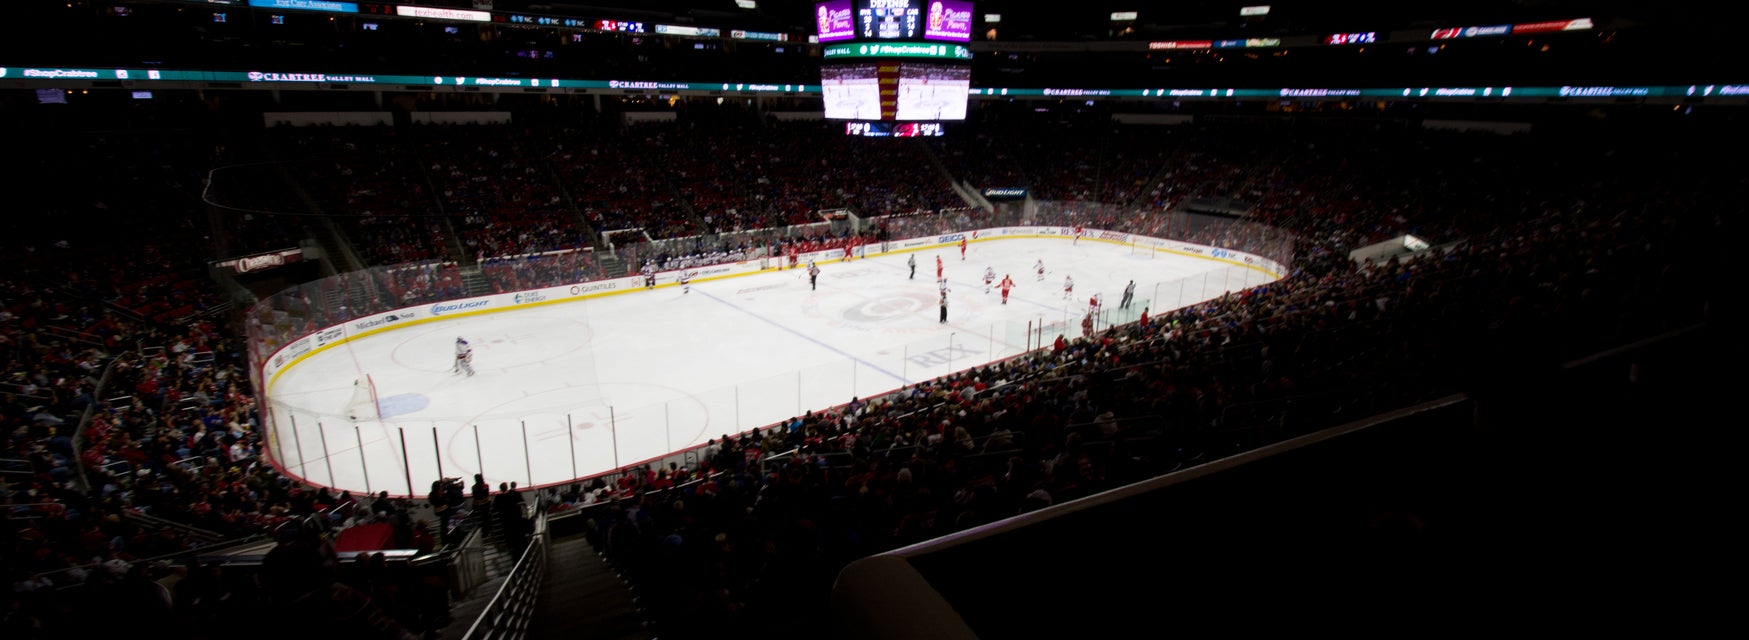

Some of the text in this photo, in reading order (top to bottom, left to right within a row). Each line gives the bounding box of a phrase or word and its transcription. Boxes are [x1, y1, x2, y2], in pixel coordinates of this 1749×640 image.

[23, 69, 98, 78] #ShopCrabtree
[263, 72, 326, 82] CRABTREE
[619, 81, 658, 89] CRABTREE
[938, 233, 964, 243] GEICO
[581, 282, 616, 293] QUINTILES
[434, 300, 489, 313] BUD LIGHT
[356, 312, 415, 330] Michael Son
[909, 343, 984, 369] REX
